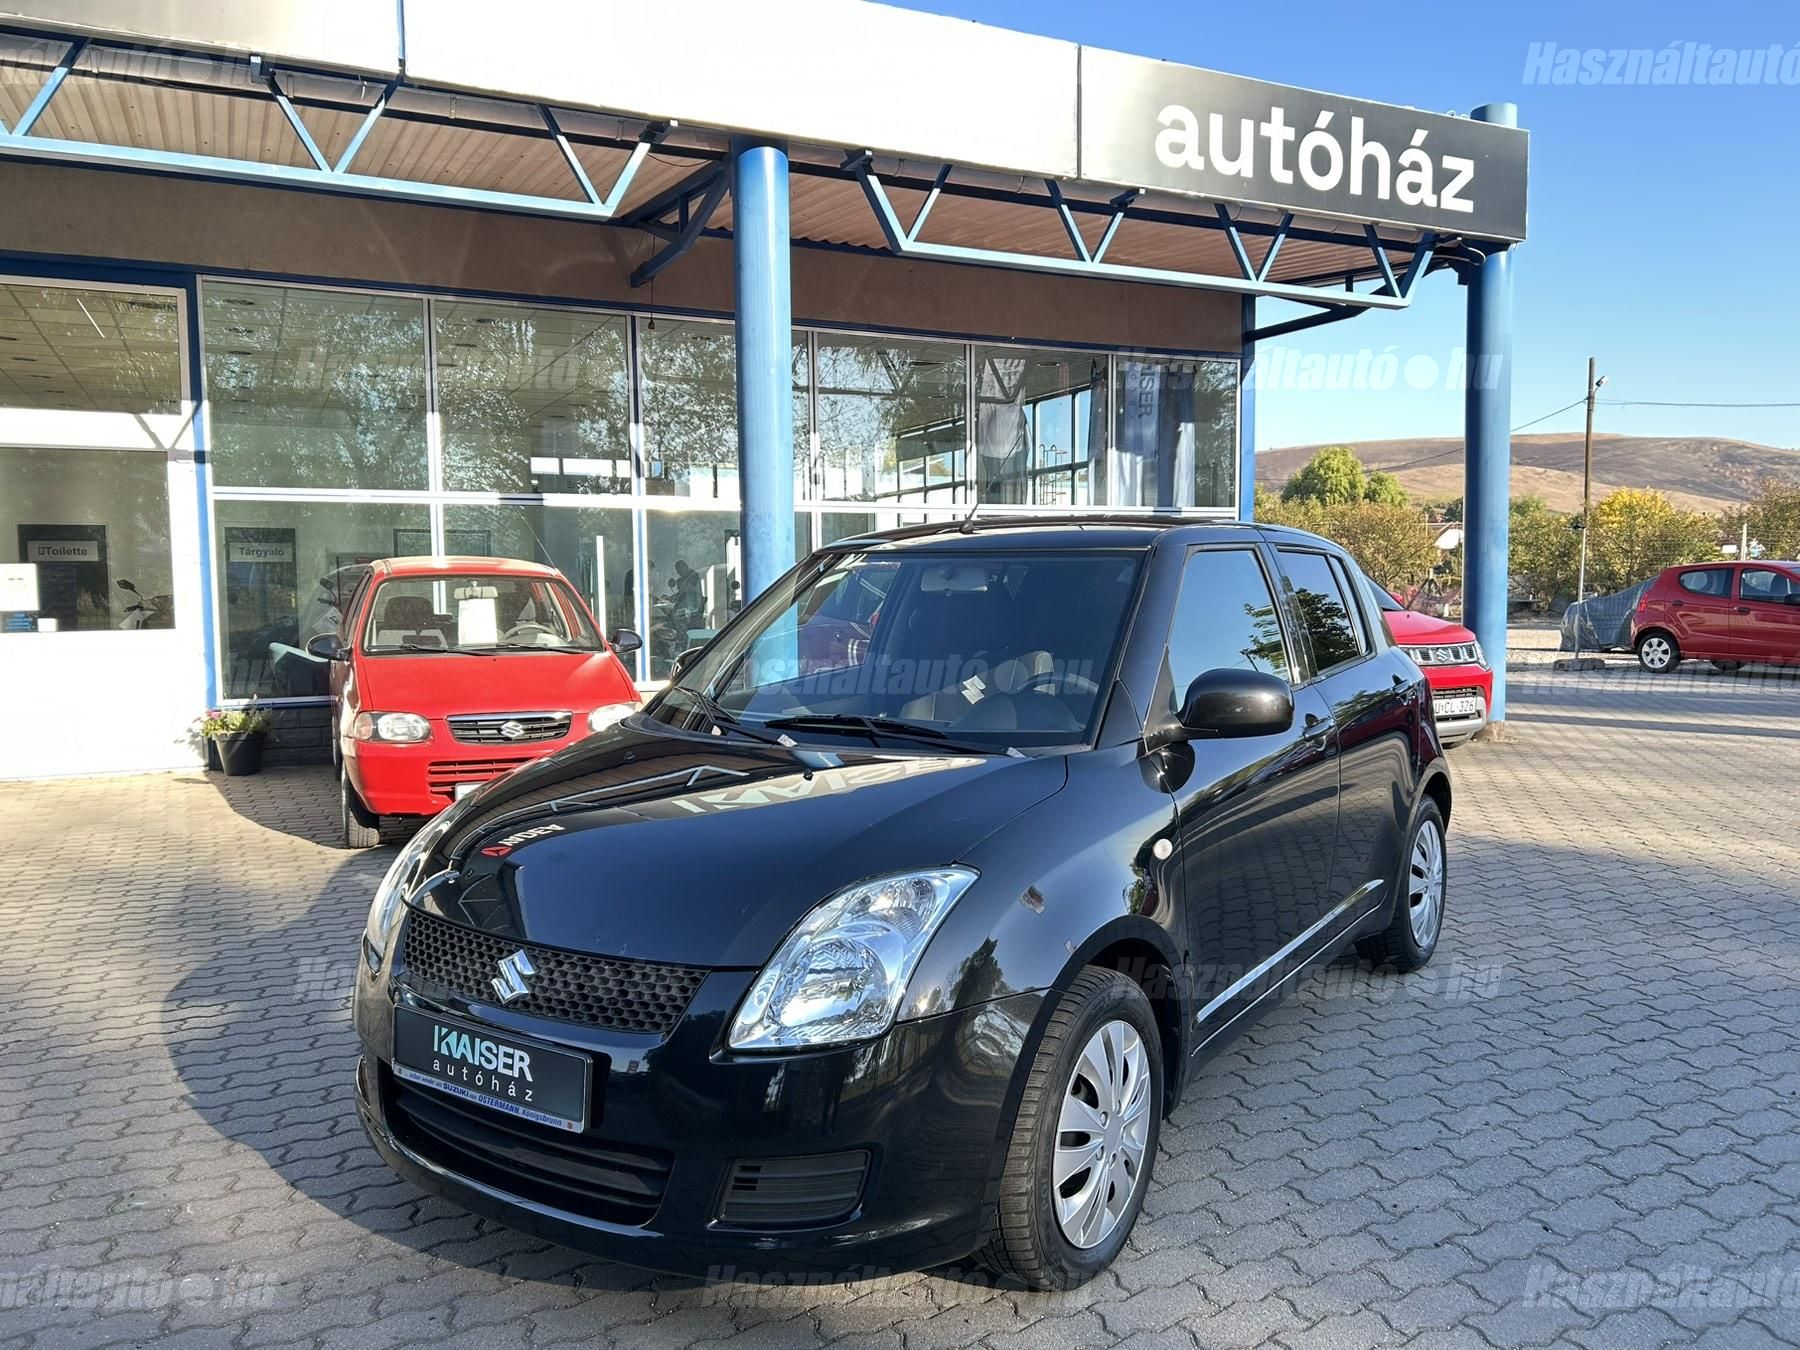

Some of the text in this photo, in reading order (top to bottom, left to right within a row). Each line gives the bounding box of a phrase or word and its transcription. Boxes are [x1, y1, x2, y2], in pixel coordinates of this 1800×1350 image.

[1154, 105, 1474, 213] autóház
[46, 546, 88, 556] Toilette
[433, 1024, 533, 1082] KAISER
[433, 1058, 533, 1102] autóház
[443, 1082, 469, 1097] SUZUKI
